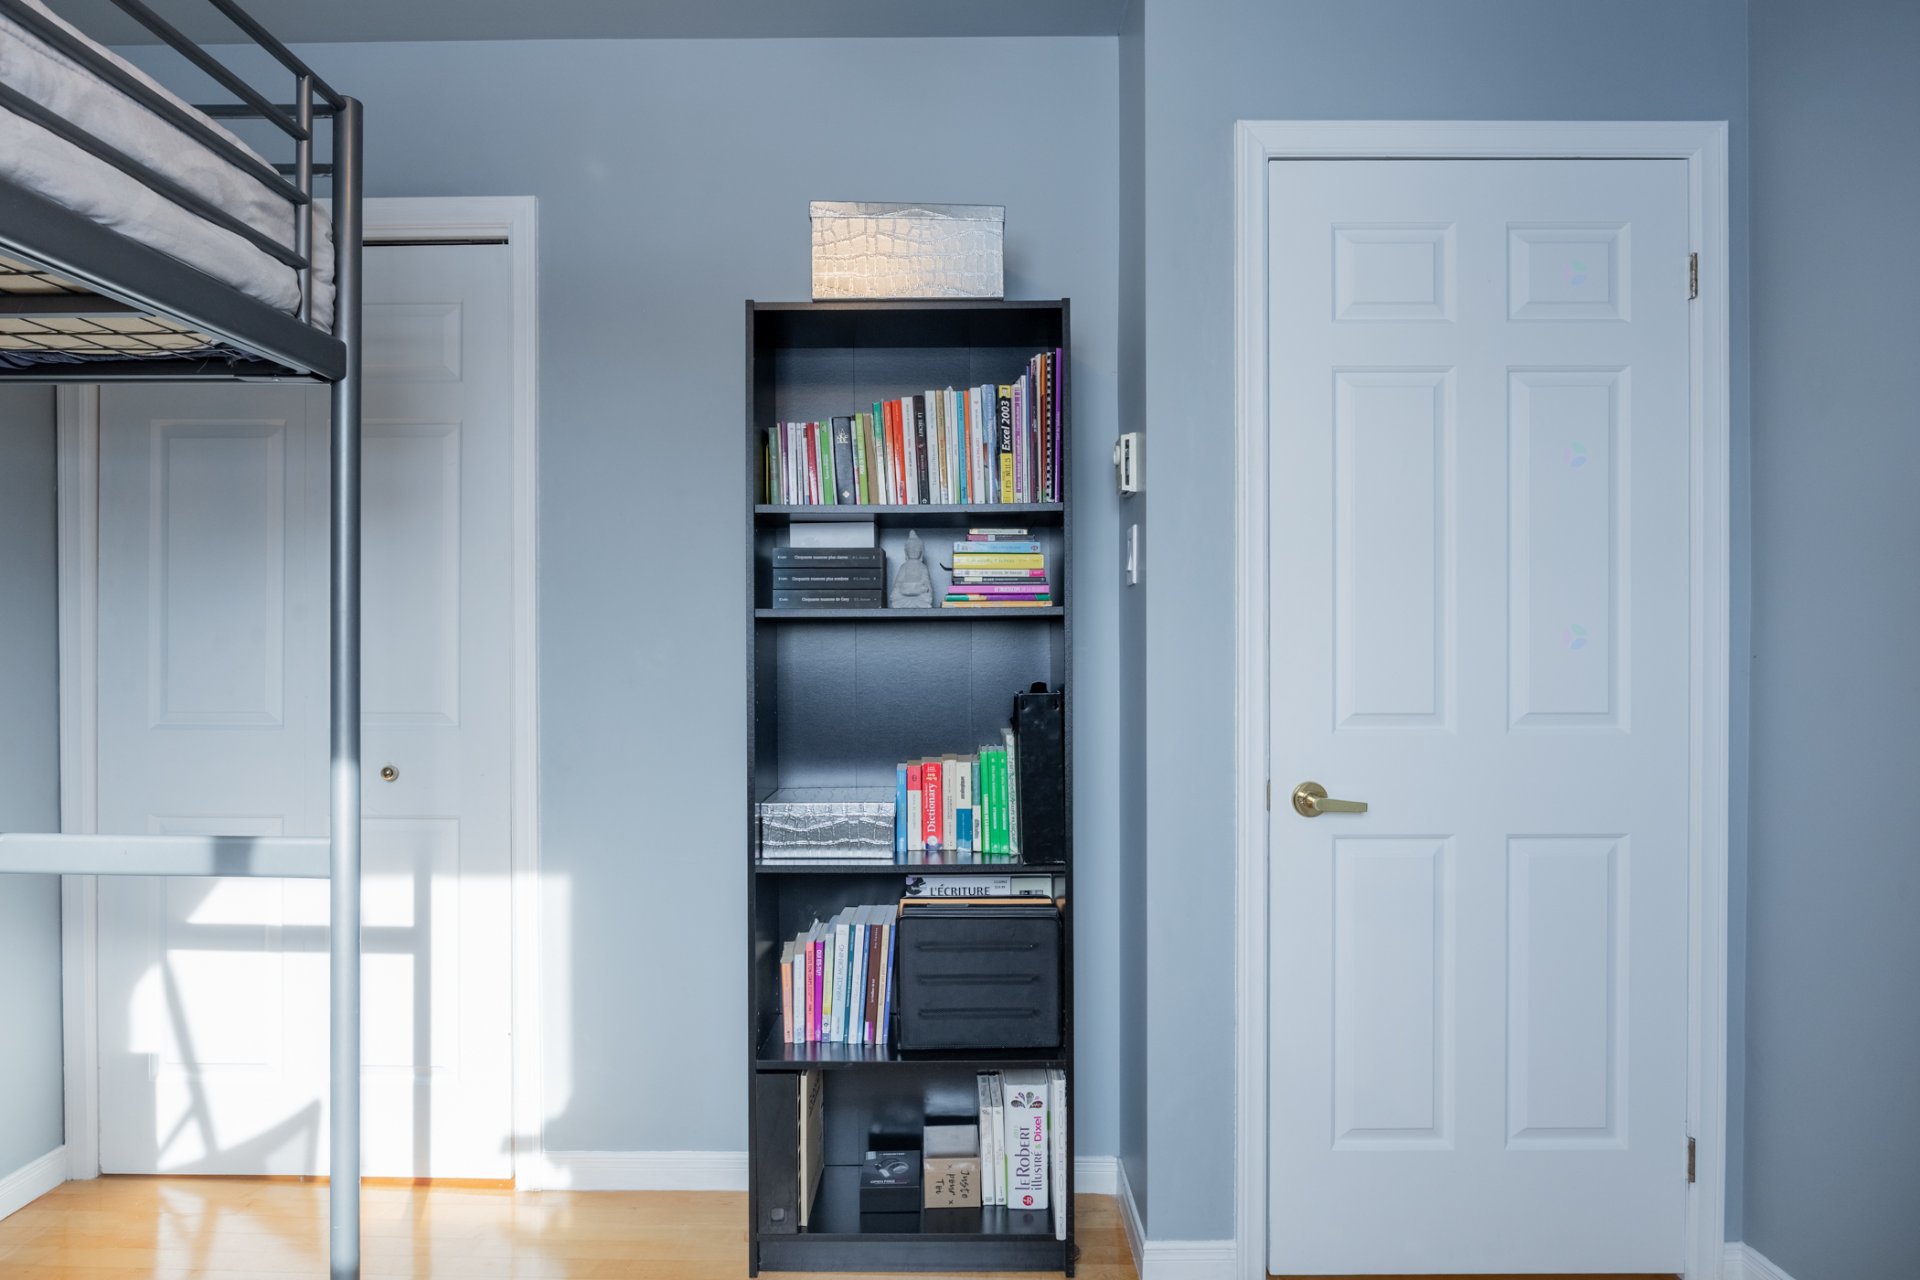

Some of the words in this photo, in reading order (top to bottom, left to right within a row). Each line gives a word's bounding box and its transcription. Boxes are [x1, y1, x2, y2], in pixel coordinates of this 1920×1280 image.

[1001, 400, 1010, 424] 2003
[1001, 425, 1011, 451] Excel
[927, 783, 938, 832] Dictionary
[930, 884, 990, 896] L'ÉCRITURE
[1034, 1116, 1042, 1142] Dixel
